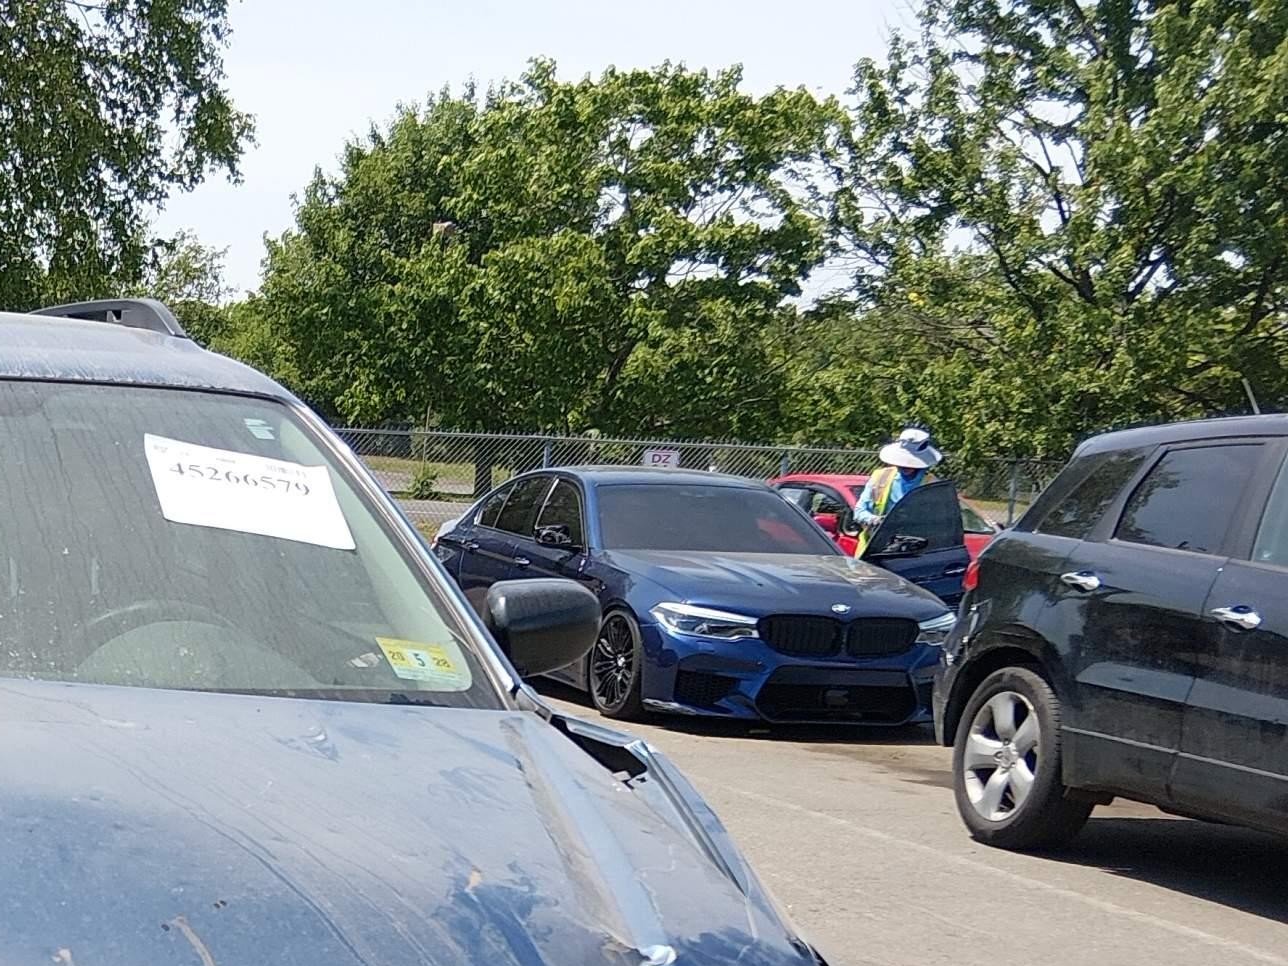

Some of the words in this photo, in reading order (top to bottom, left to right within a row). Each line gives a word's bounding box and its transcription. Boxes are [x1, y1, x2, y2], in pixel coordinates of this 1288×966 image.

[652, 454, 671, 464] DZ
[170, 462, 310, 496] 45266579
[413, 652, 426, 667] 5
